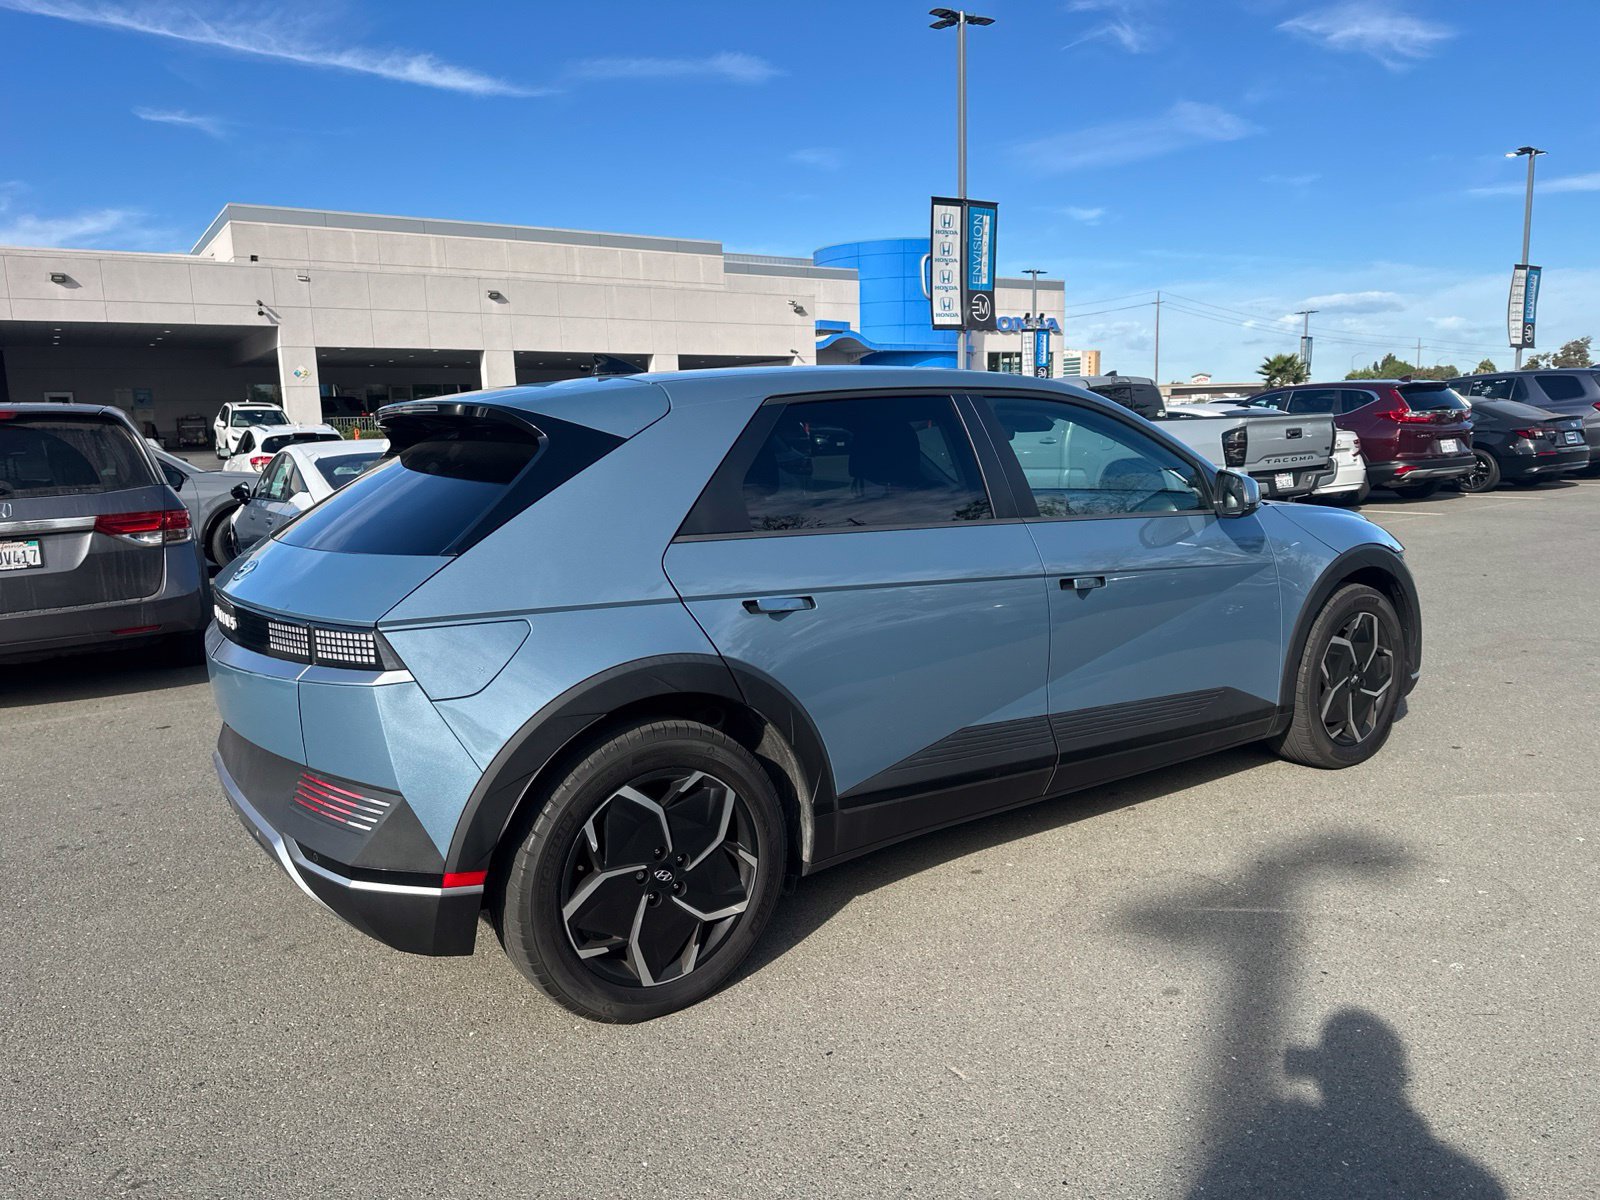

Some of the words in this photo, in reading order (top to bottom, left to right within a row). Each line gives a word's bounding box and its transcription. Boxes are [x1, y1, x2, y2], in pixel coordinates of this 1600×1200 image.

[973, 214, 983, 284] ENVISION
[997, 316, 1060, 331] ONA
[1265, 455, 1314, 464] TACOMA
[0, 550, 37, 565] V417
